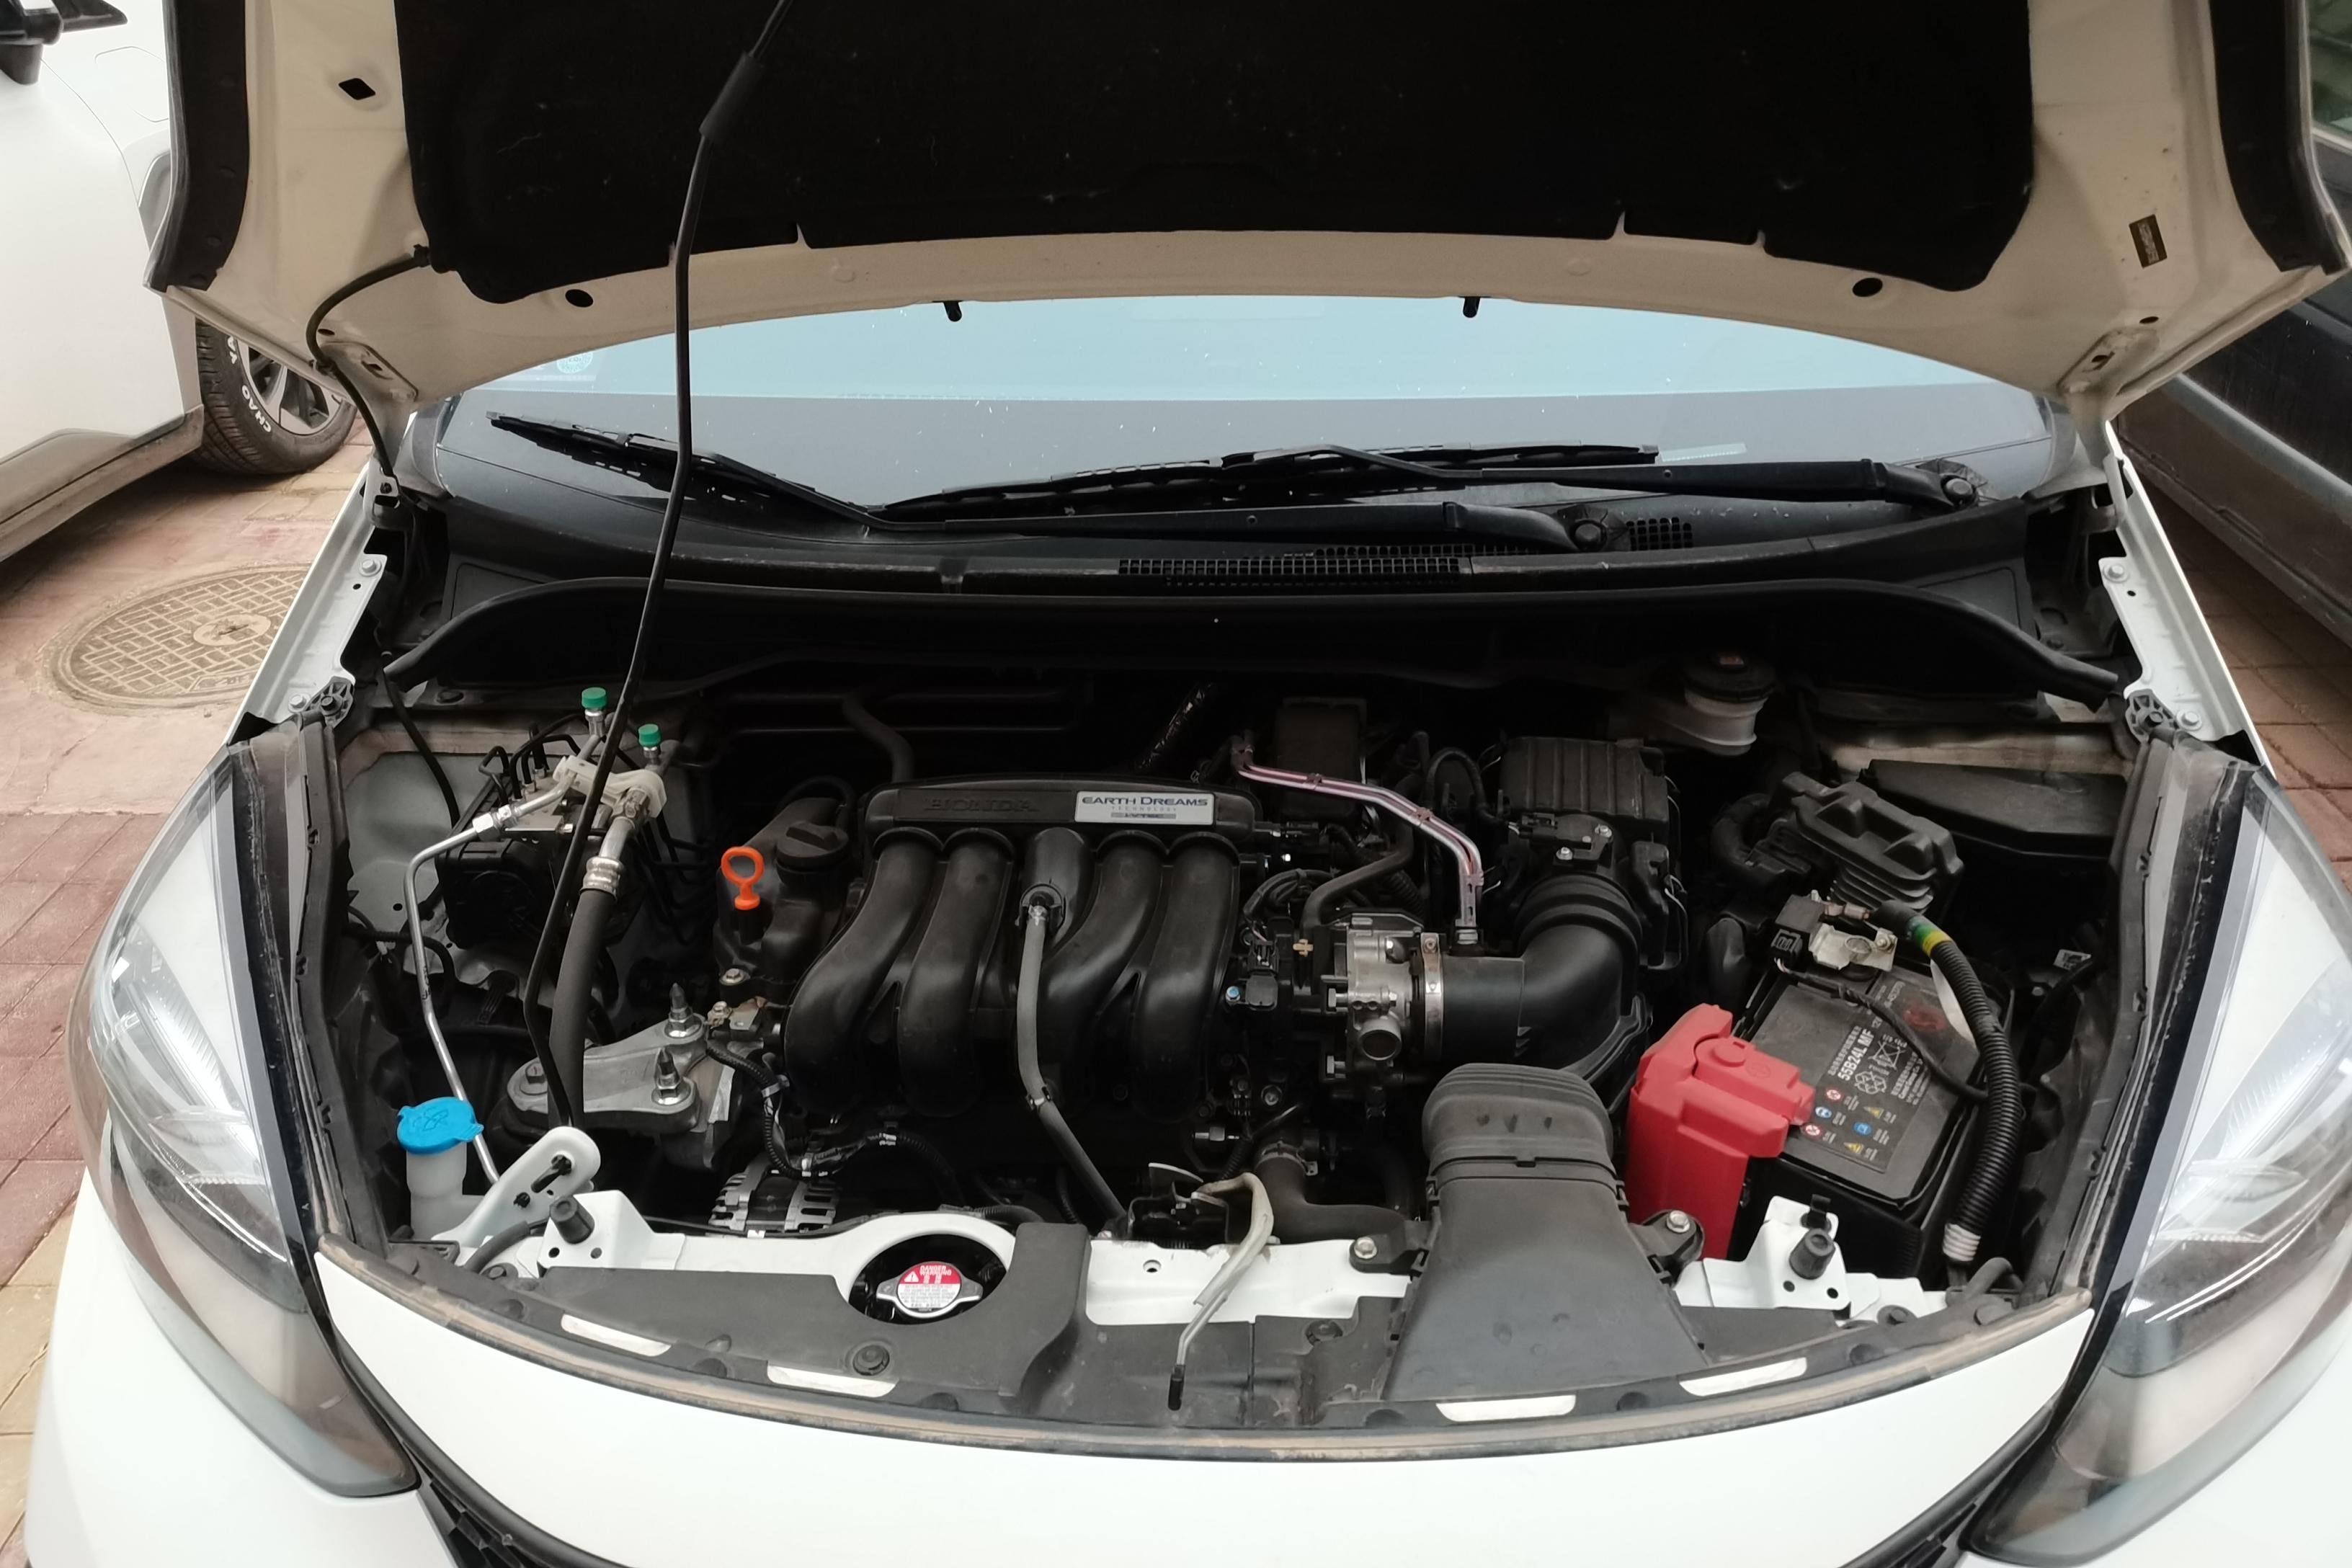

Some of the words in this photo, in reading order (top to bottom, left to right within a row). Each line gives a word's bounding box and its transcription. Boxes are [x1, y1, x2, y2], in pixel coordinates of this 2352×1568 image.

[241, 384, 272, 432] CHAO
[924, 798, 1040, 812] HONDA
[1082, 796, 1136, 805] EARTH
[1141, 796, 1208, 806] DREAMS
[1838, 1047, 1868, 1081] 55B24L
[1858, 1029, 1874, 1047] MF
